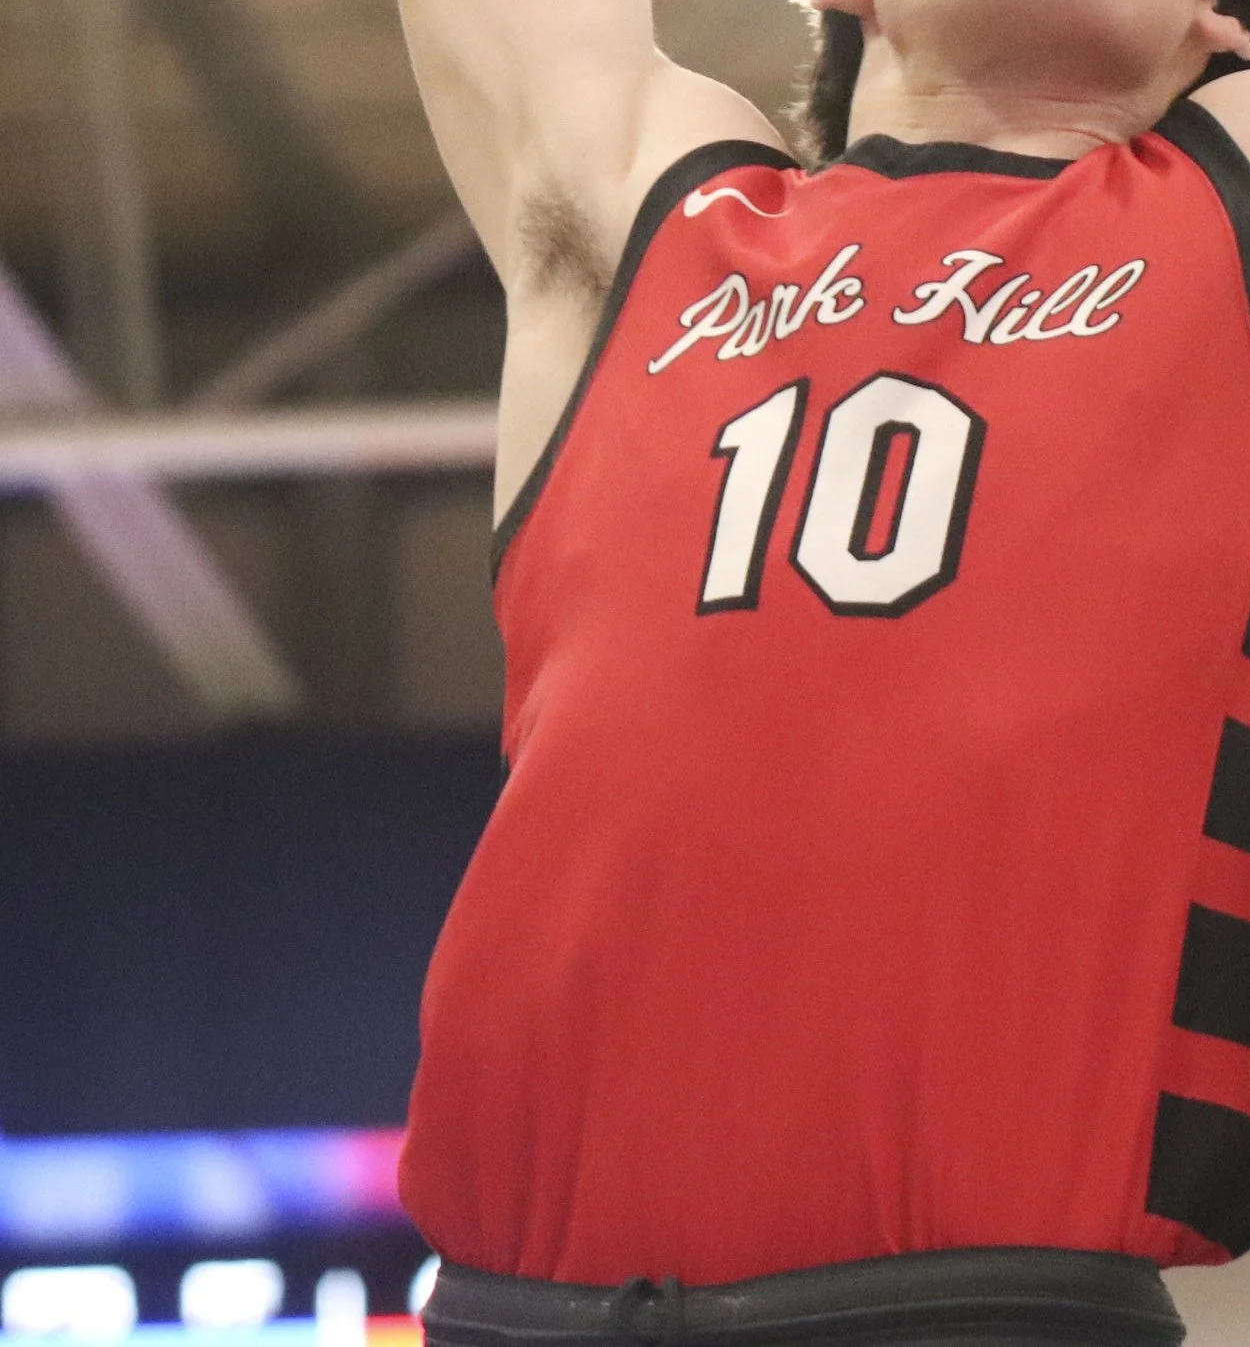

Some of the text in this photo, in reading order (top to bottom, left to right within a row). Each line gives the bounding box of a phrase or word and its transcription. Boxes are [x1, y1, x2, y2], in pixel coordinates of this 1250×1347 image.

[646, 243, 1148, 376] Park Hill
[695, 369, 989, 620] 10
